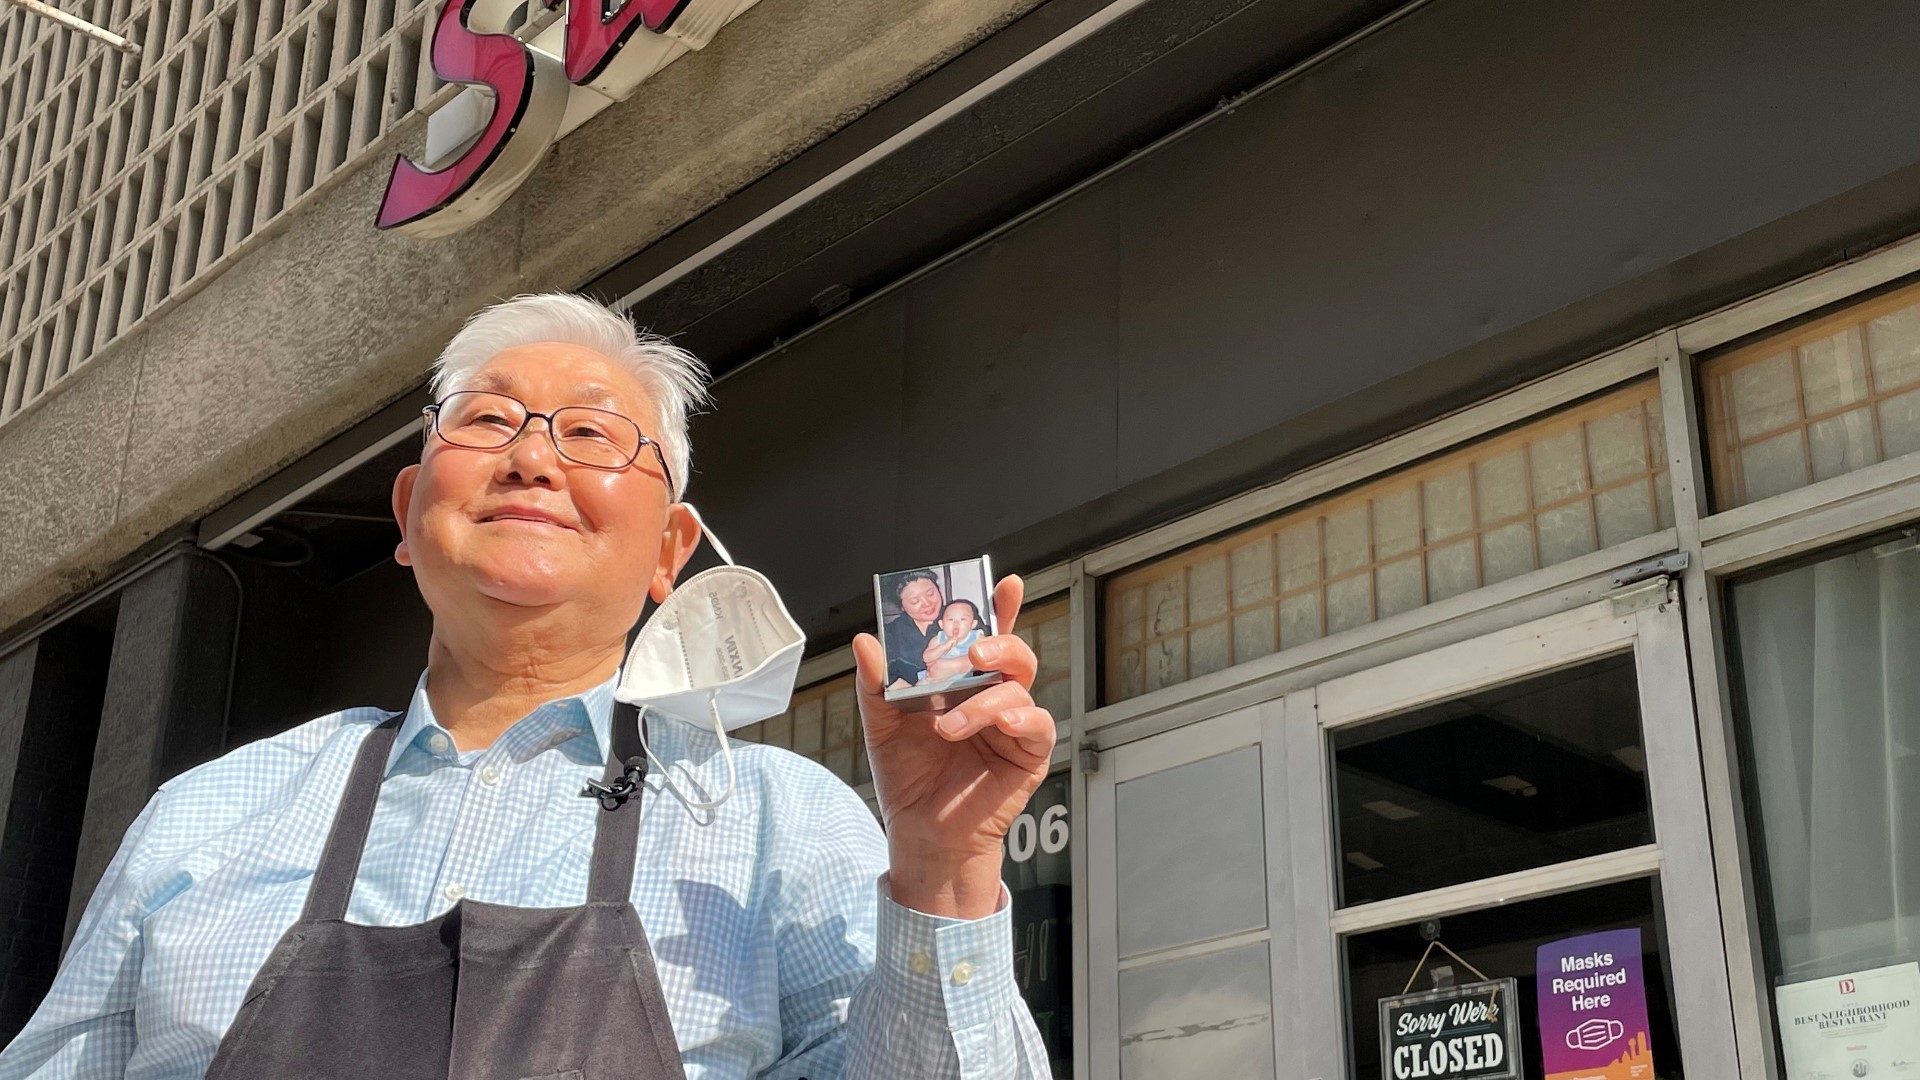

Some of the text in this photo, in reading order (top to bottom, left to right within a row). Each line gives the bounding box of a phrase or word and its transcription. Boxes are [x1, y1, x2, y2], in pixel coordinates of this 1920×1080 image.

[1001, 804, 1069, 863] 06
[1561, 952, 1613, 973] Masks
[1552, 968, 1626, 994] Required
[1571, 994, 1611, 1011] Here
[1794, 999, 1910, 1026] BEST NEIGHBORHOOD
[1396, 1012, 1446, 1038] Sorry
[1818, 1012, 1887, 1029] RESTAURANT
[1393, 1033, 1503, 1079] CLOSED
